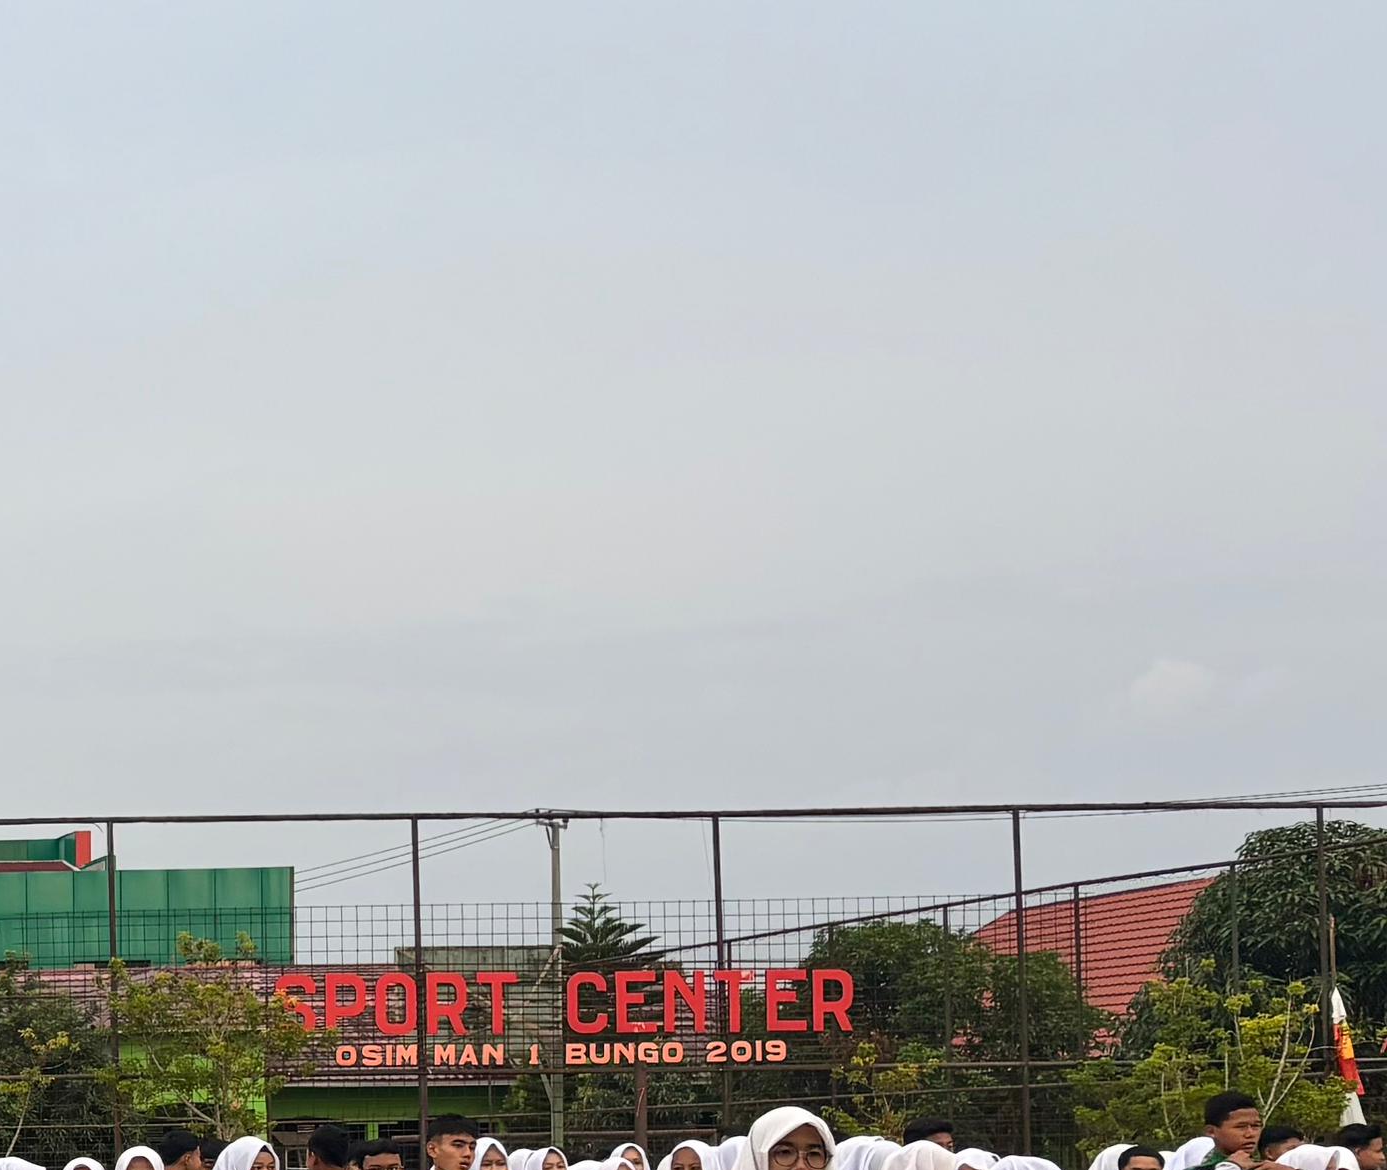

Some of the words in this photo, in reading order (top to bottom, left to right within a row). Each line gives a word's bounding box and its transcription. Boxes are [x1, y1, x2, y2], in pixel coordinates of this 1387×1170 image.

[274, 971, 519, 1035] SPORT
[566, 968, 855, 1034] CENTER
[335, 1044, 418, 1067] OSIM
[433, 1043, 505, 1066] MAN
[529, 1044, 540, 1066] 1
[565, 1042, 685, 1065] BUNGO
[706, 1040, 788, 1062] 2019
